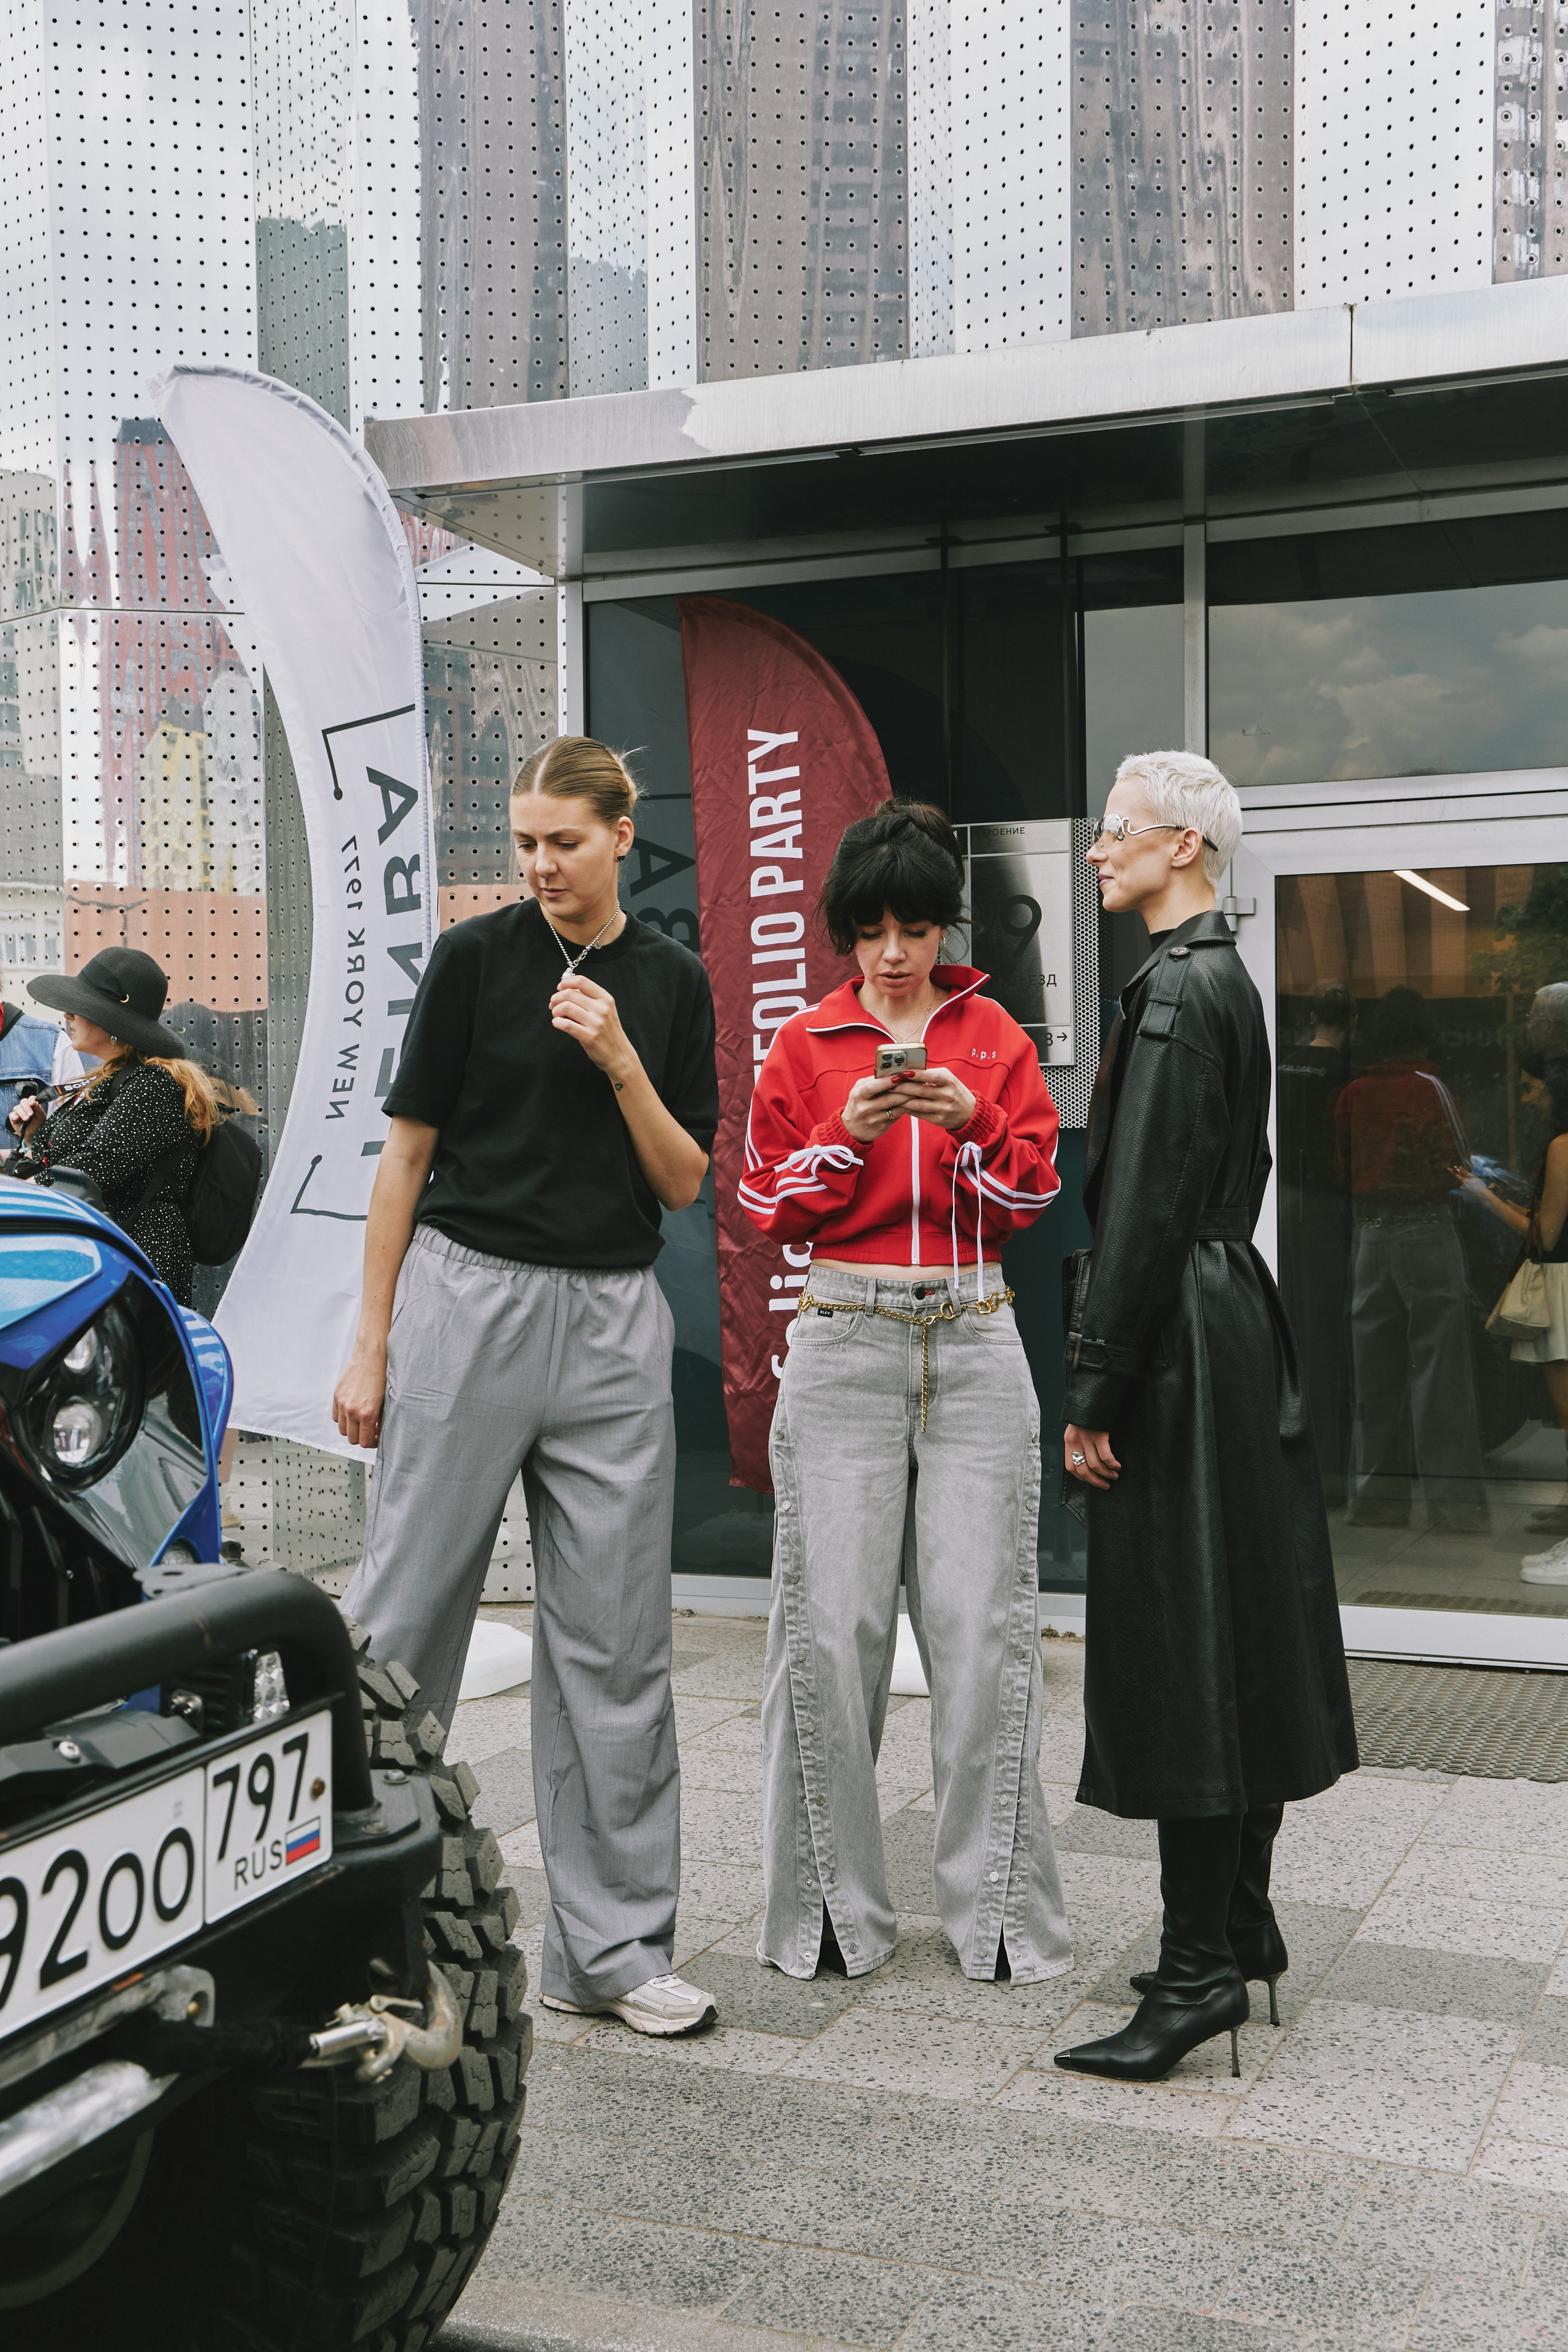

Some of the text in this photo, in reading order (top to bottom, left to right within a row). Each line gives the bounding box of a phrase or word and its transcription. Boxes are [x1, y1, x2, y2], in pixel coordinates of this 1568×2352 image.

[747, 729, 804, 898] PARTY
[1000, 894, 1042, 959] 9
[1044, 1032, 1054, 1047] 8
[213, 1732, 309, 1862] 797
[234, 1839, 283, 1891] RUS
